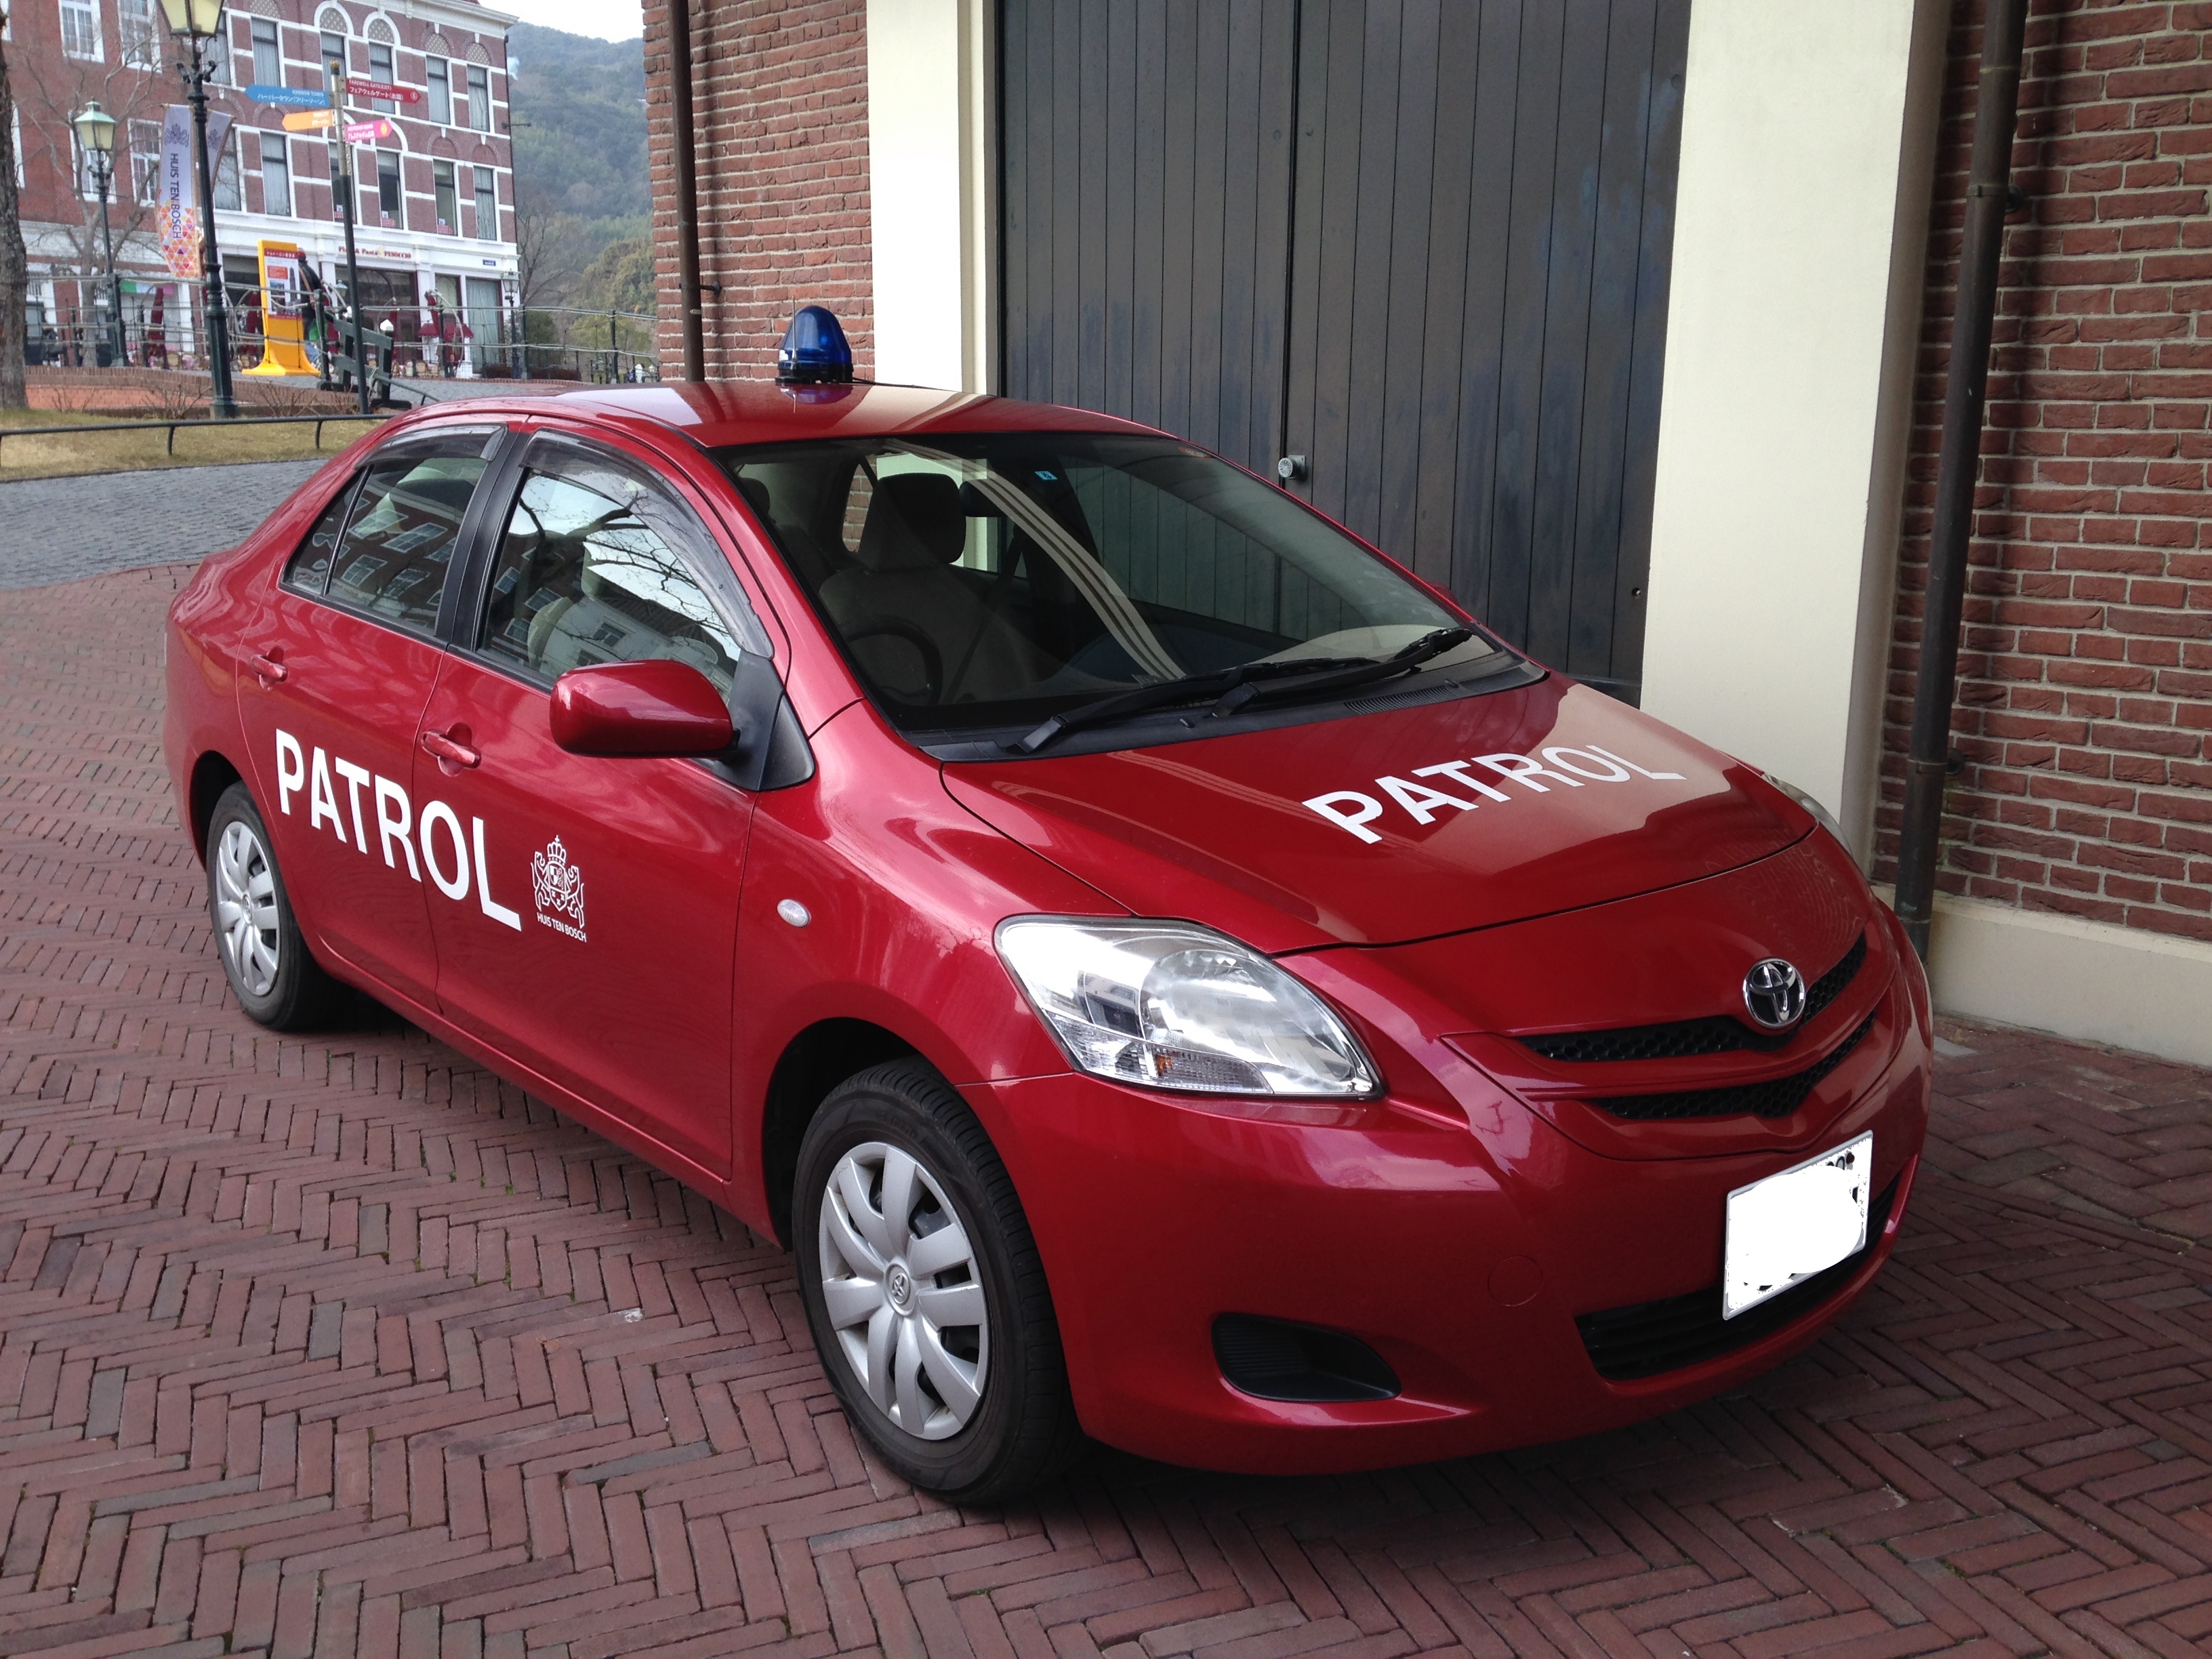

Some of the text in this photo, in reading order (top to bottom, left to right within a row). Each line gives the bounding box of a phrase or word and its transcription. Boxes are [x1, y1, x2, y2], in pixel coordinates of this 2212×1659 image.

[170, 153, 182, 239] HUIS TEN BOSCH
[276, 729, 522, 932] PATROL
[1302, 745, 1687, 844] PATROL
[537, 912, 587, 943] HUIS TEN BOSCH
